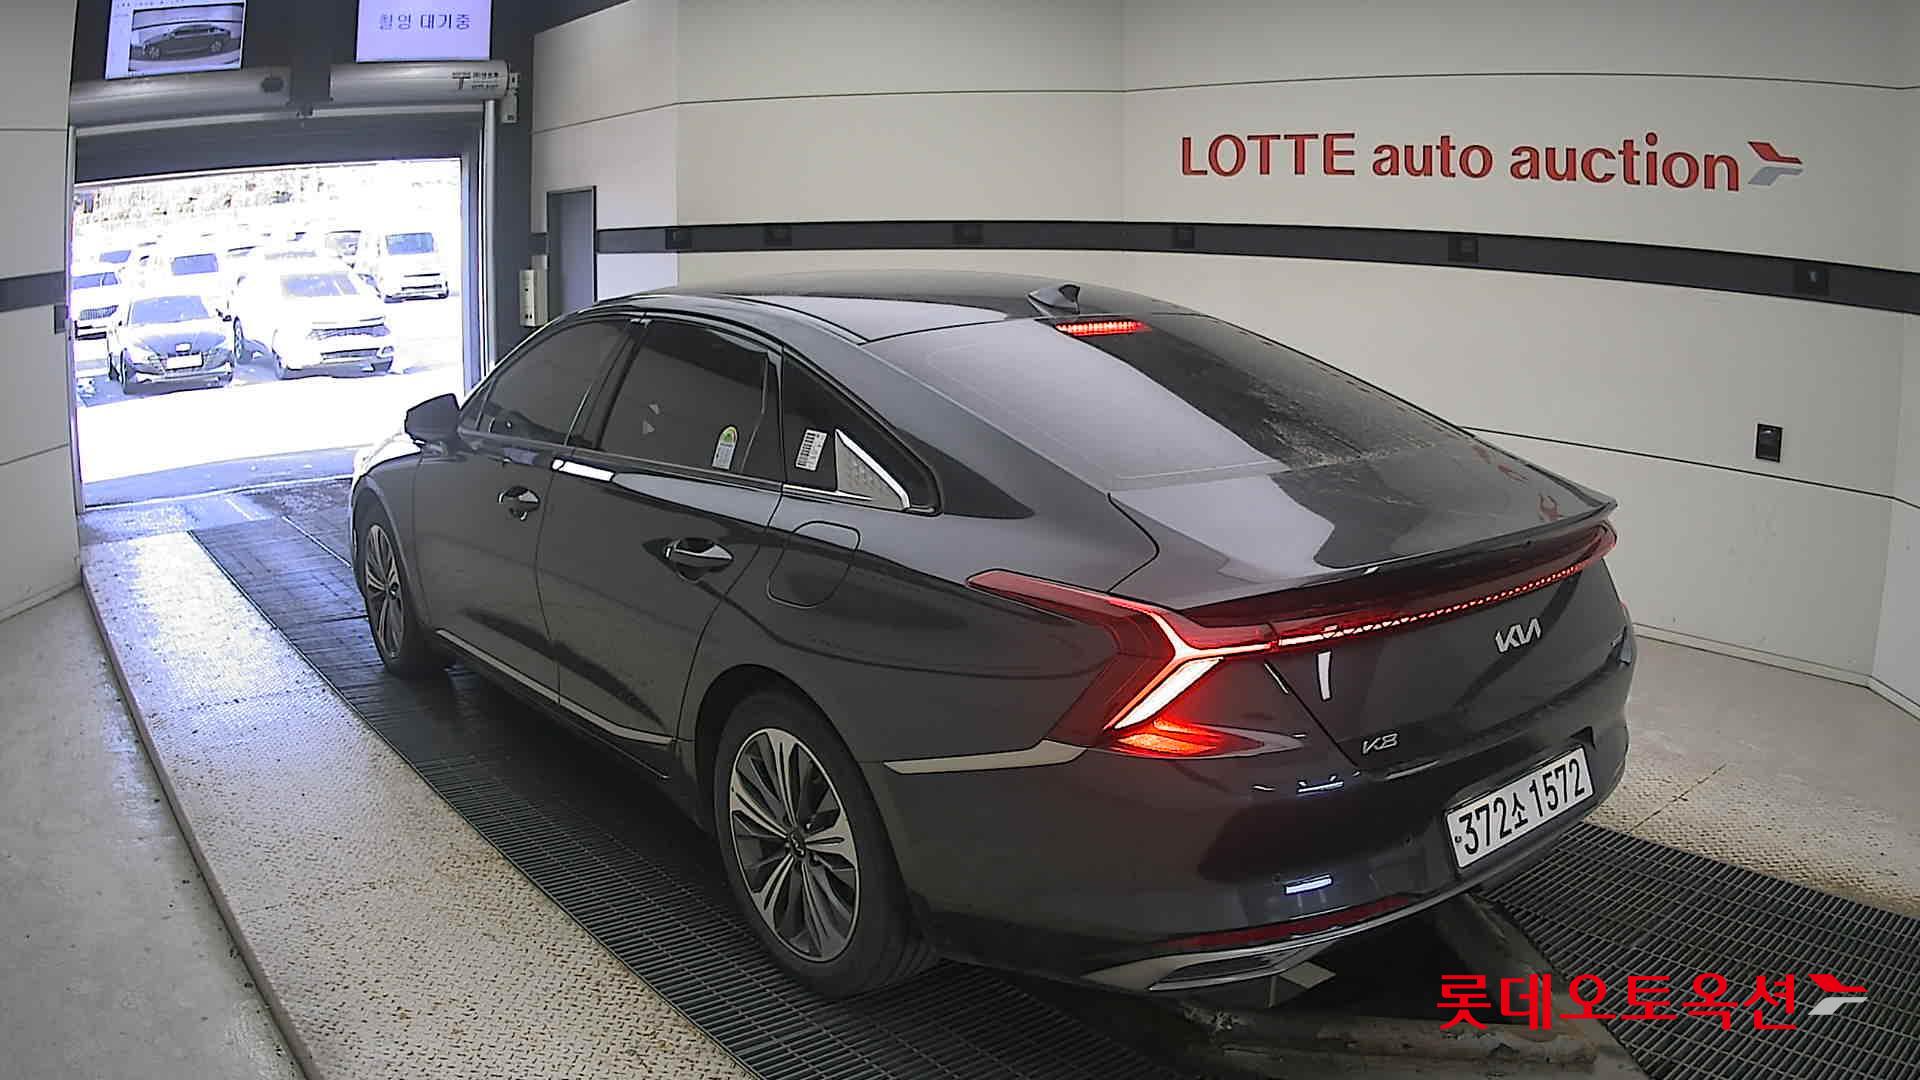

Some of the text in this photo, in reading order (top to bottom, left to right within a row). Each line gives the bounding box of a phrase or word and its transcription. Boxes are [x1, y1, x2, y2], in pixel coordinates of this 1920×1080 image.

[420, 13, 472, 31] 대기중
[1182, 131, 1740, 192] LOTTE auto auction
[1495, 617, 1542, 653] KIA
[1361, 732, 1398, 754] K8
